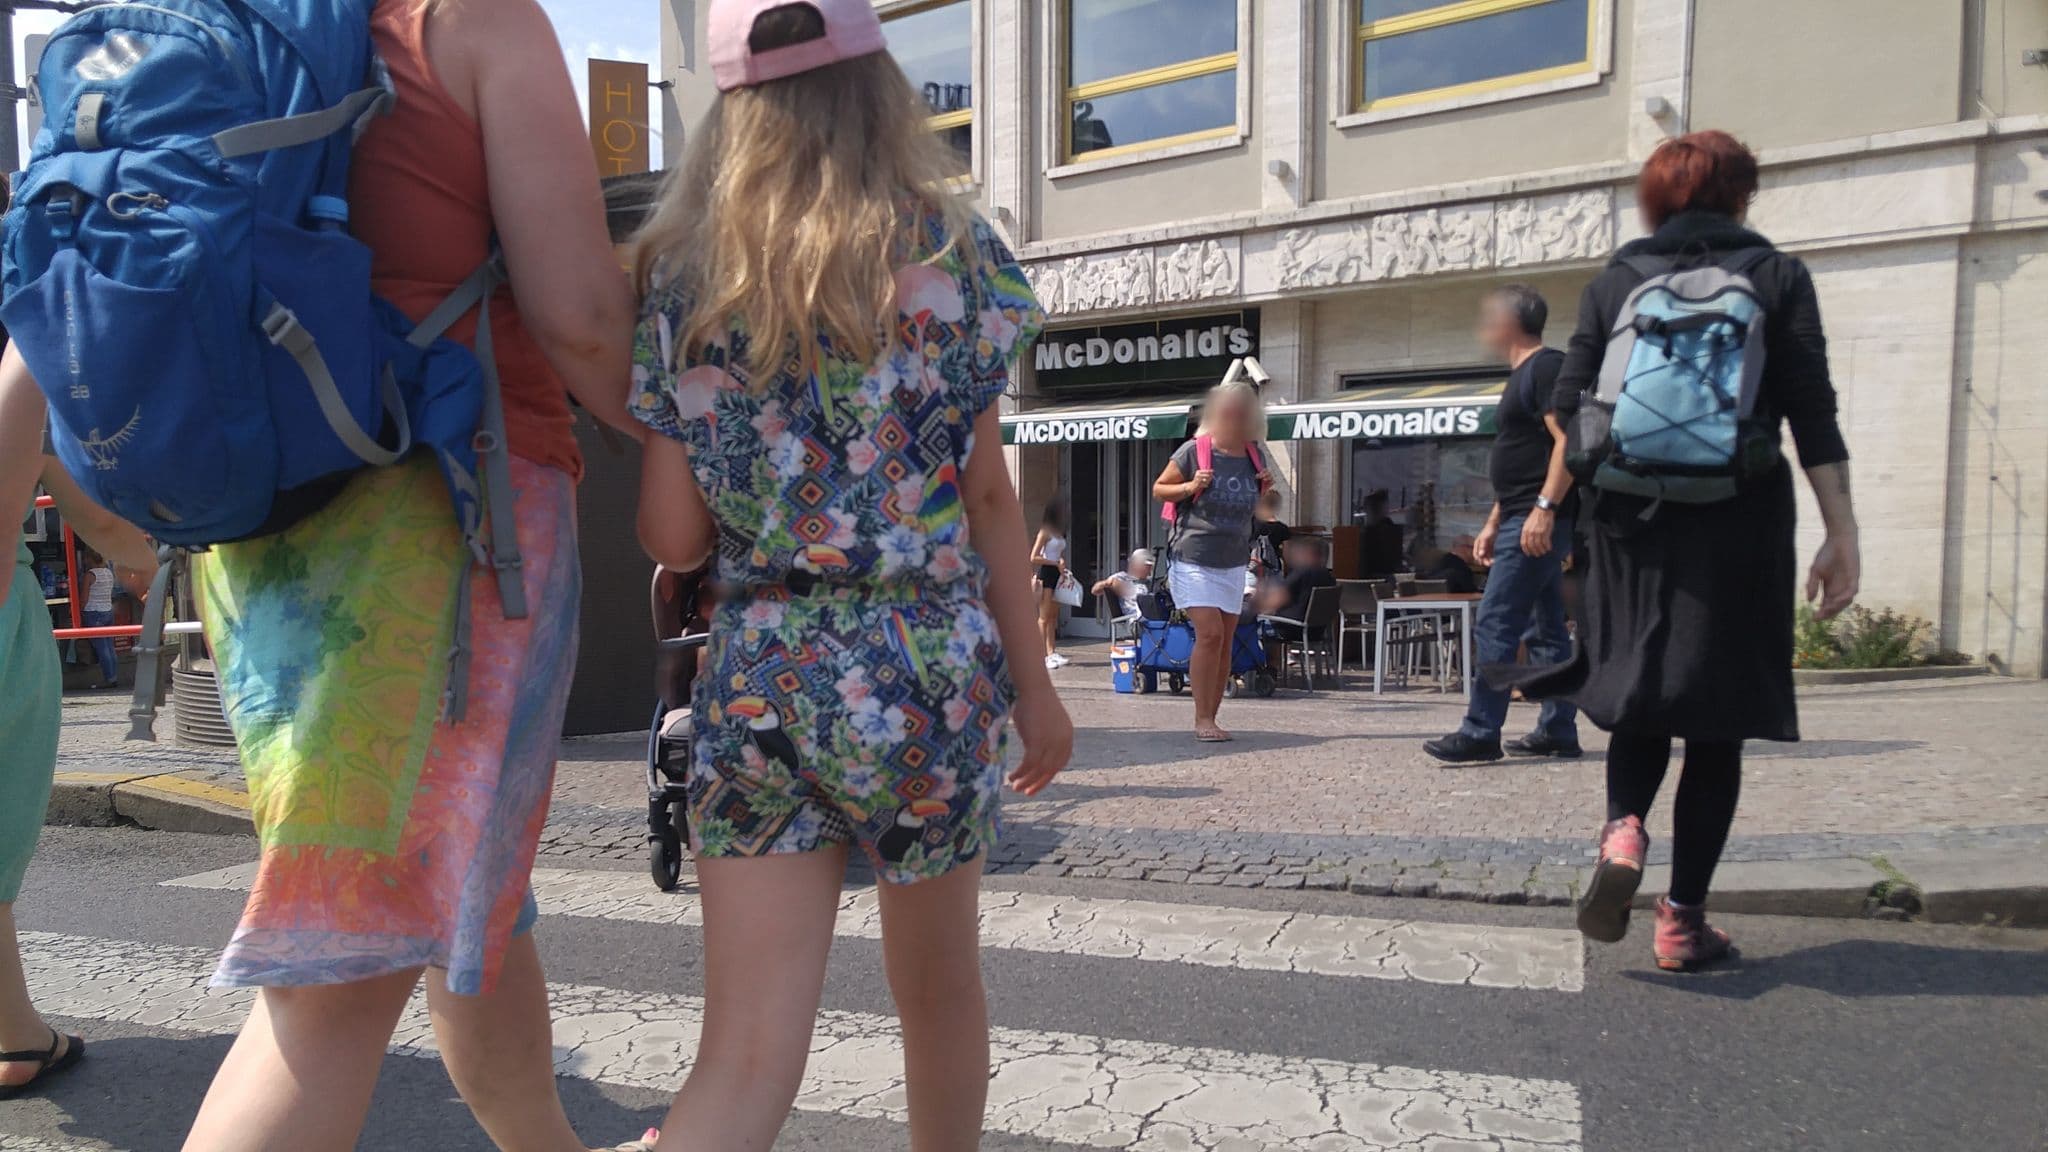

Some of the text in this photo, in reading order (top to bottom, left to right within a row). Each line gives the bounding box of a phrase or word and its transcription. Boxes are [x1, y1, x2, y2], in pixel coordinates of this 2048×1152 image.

[1035, 326, 1252, 371] McDonald's
[1014, 417, 1149, 444] McDonald's
[1292, 406, 1480, 439] McDonald's
